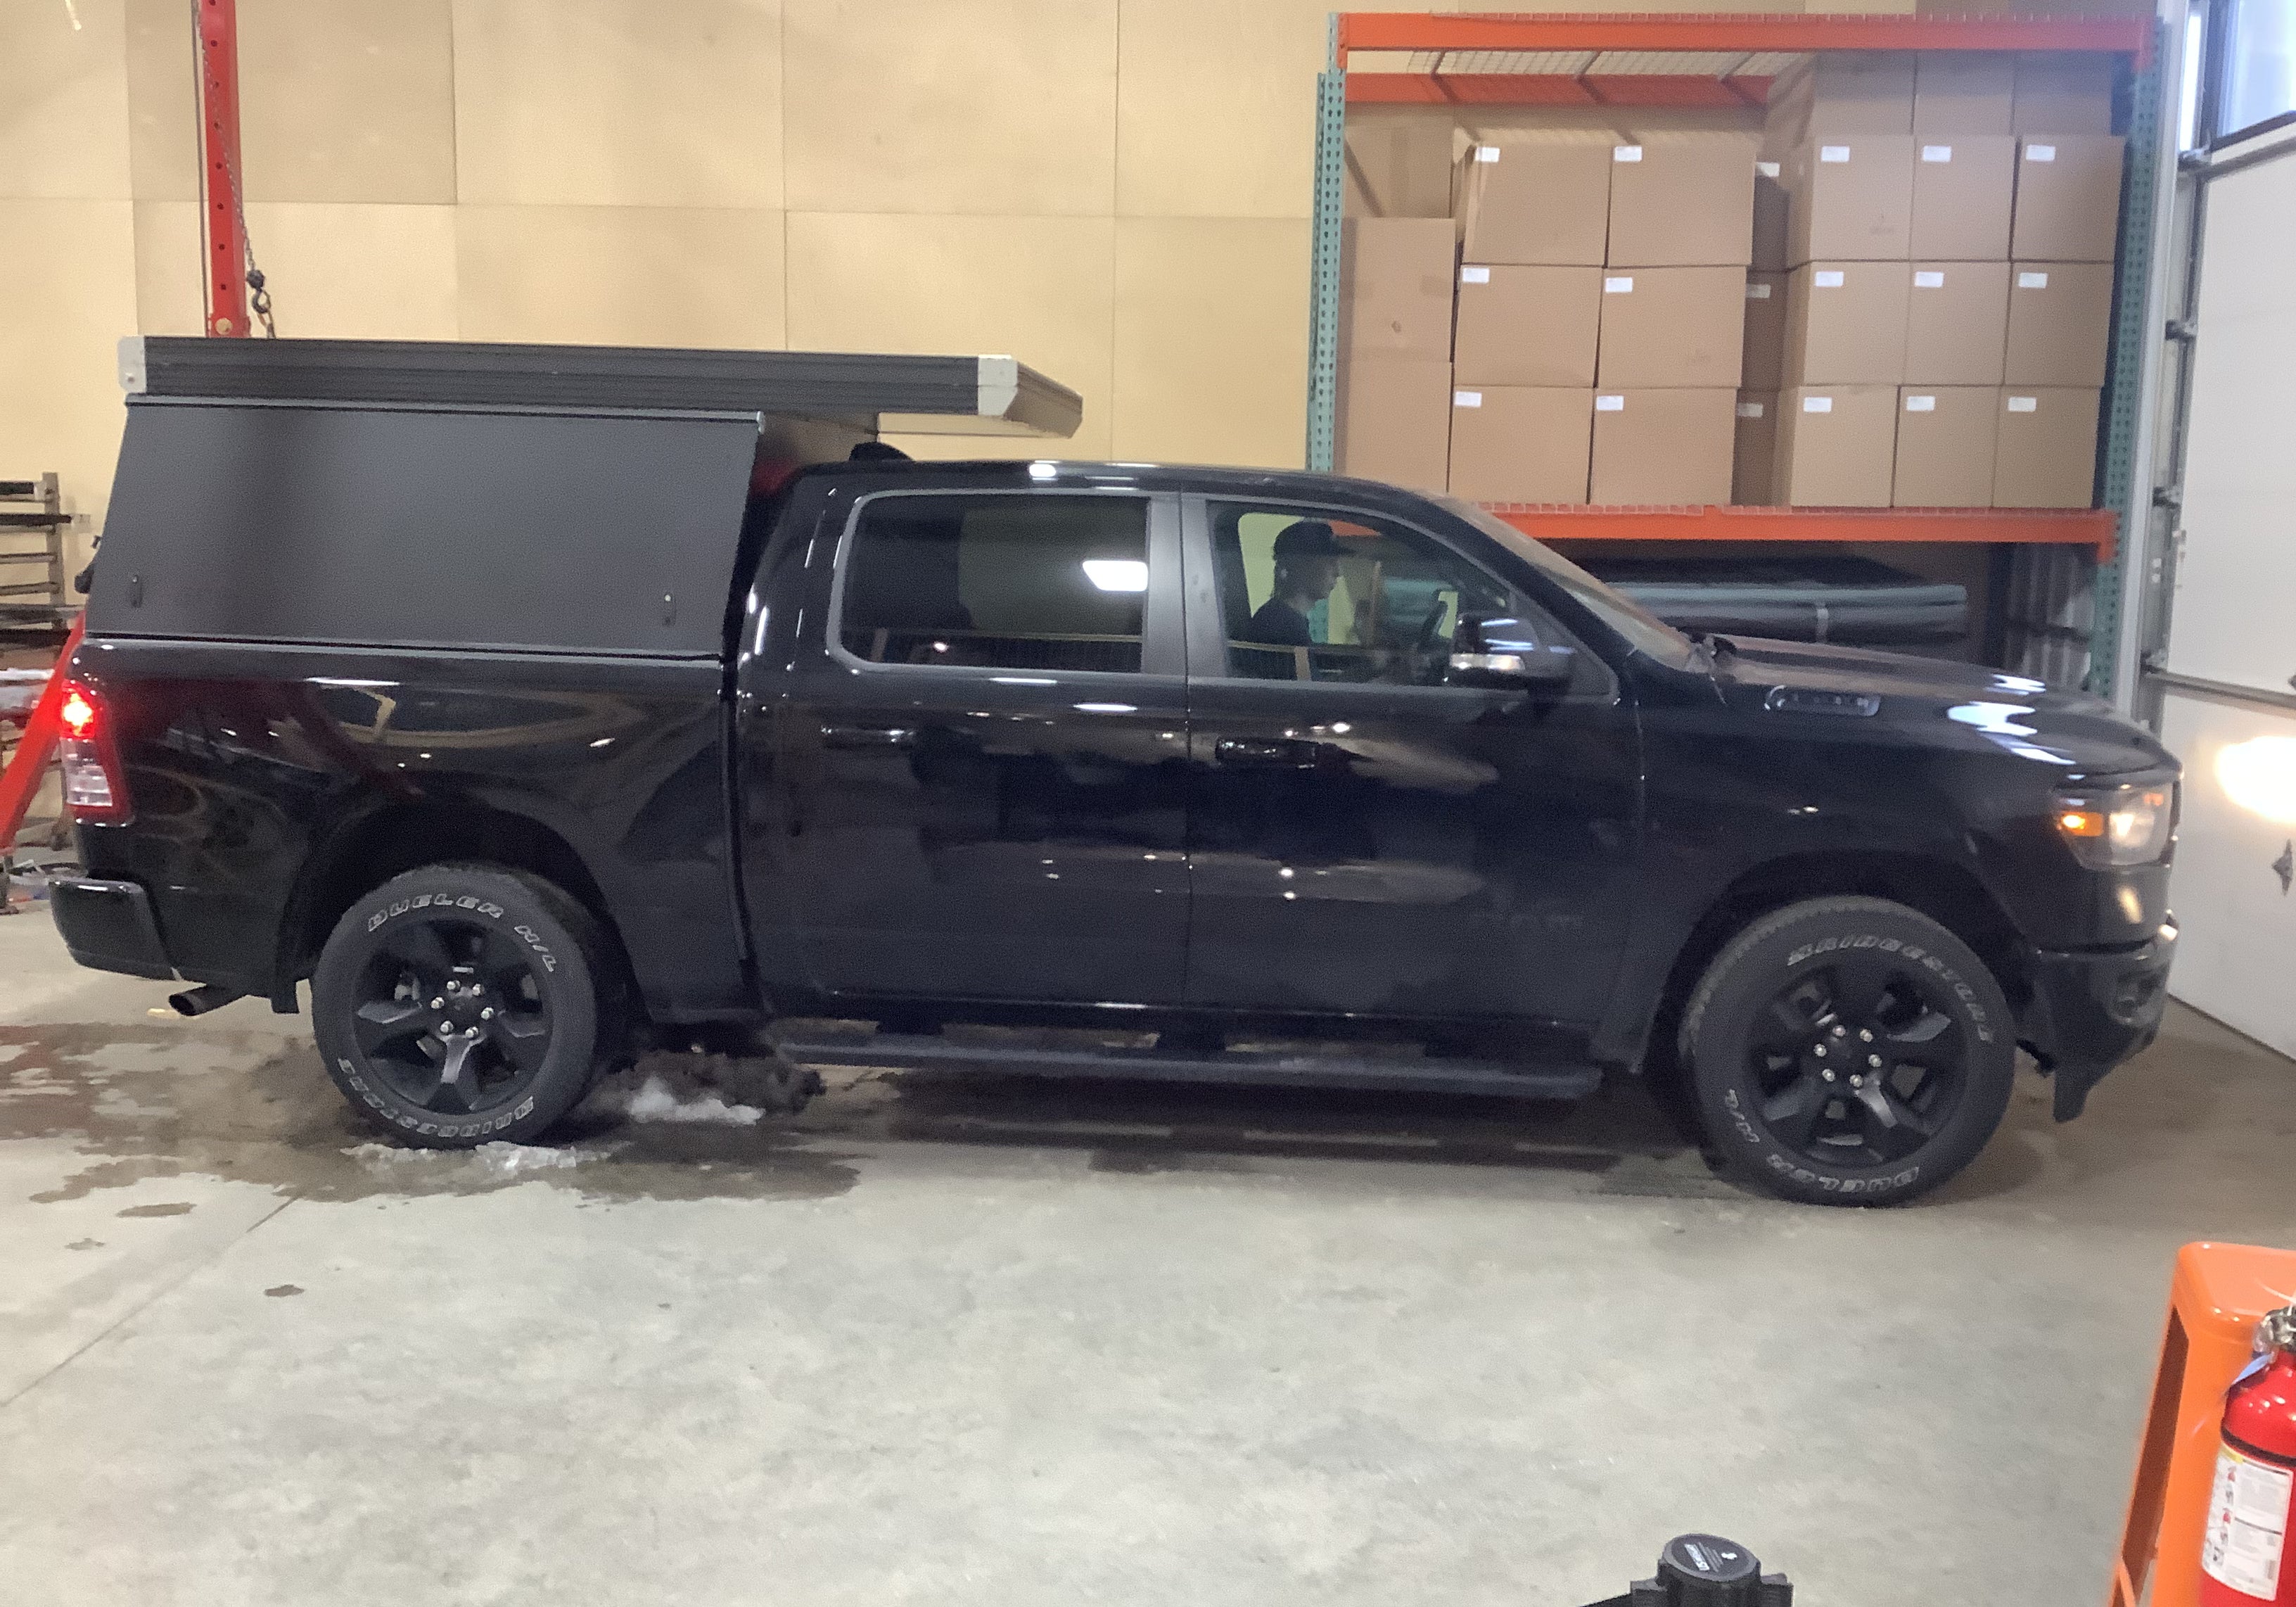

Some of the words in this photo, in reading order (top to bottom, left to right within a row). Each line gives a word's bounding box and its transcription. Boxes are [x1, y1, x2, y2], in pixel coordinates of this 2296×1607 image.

[368, 893, 504, 932] DUELER
[514, 925, 557, 972] H/L
[1787, 934, 1995, 1043] BRIDGESTONE
[337, 1057, 535, 1138] BRIDGESTONE
